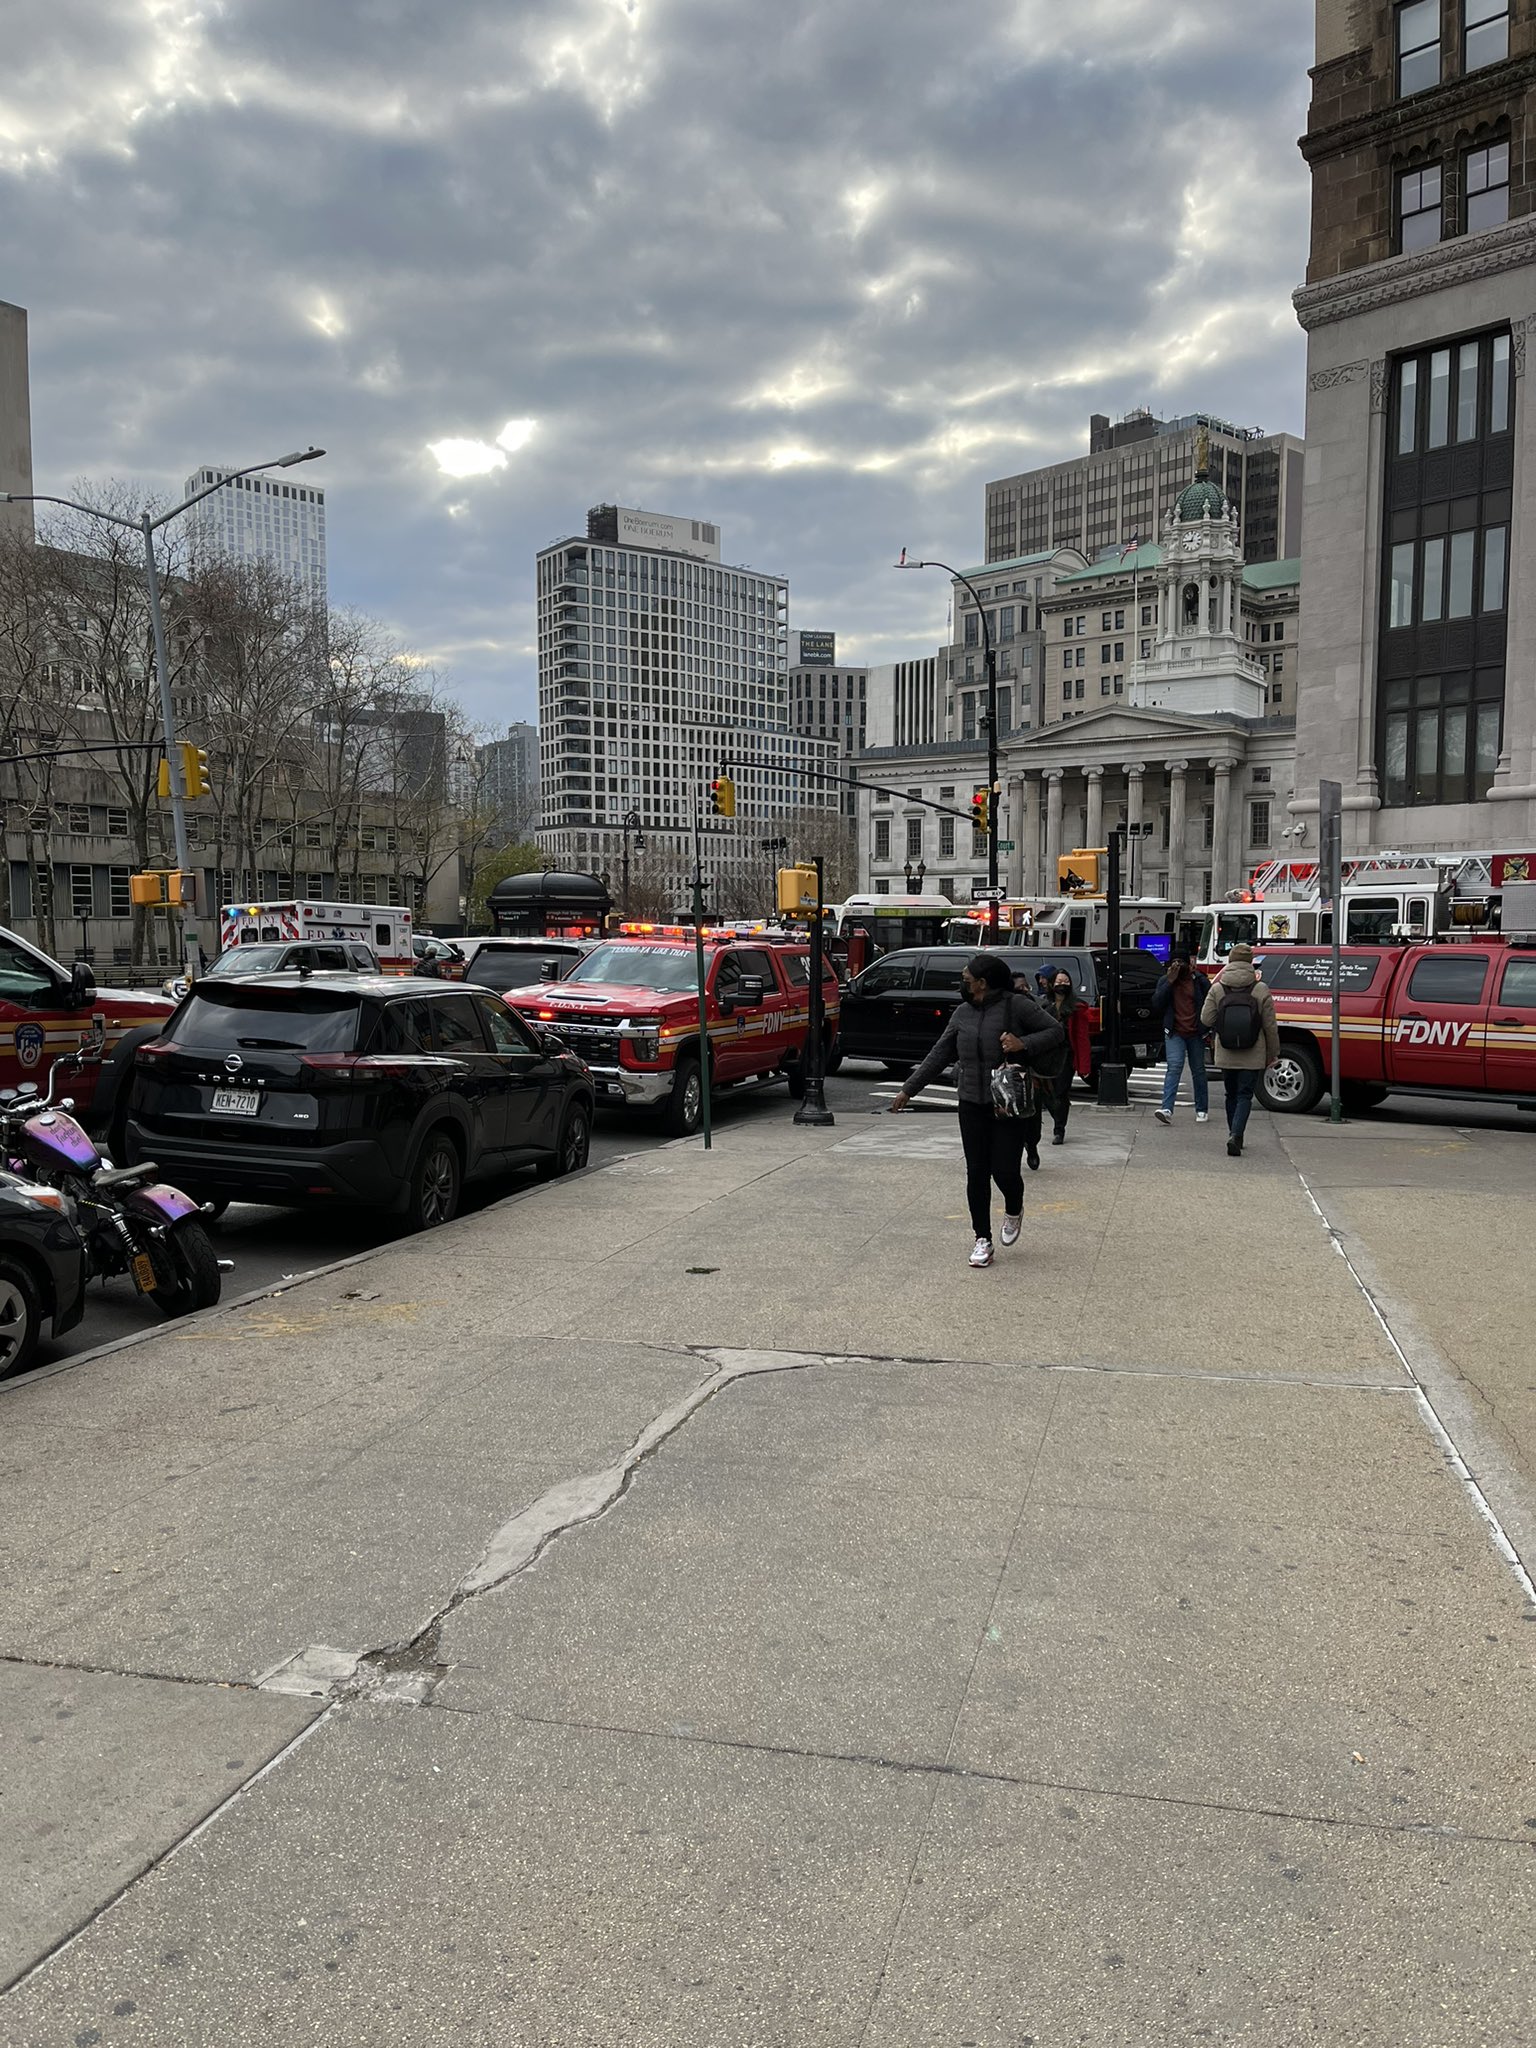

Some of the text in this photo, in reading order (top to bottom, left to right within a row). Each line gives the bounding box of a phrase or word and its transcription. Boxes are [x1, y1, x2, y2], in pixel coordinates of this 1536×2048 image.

[801, 640, 834, 649] THE LANE
[976, 889, 1002, 898] ONE WAY
[670, 948, 691, 958] THAT
[1306, 996, 1333, 1004] BATTALIO
[762, 1010, 785, 1035] FDNY
[1394, 1019, 1471, 1046] FDNY
[198, 1073, 265, 1086] ROGUE
